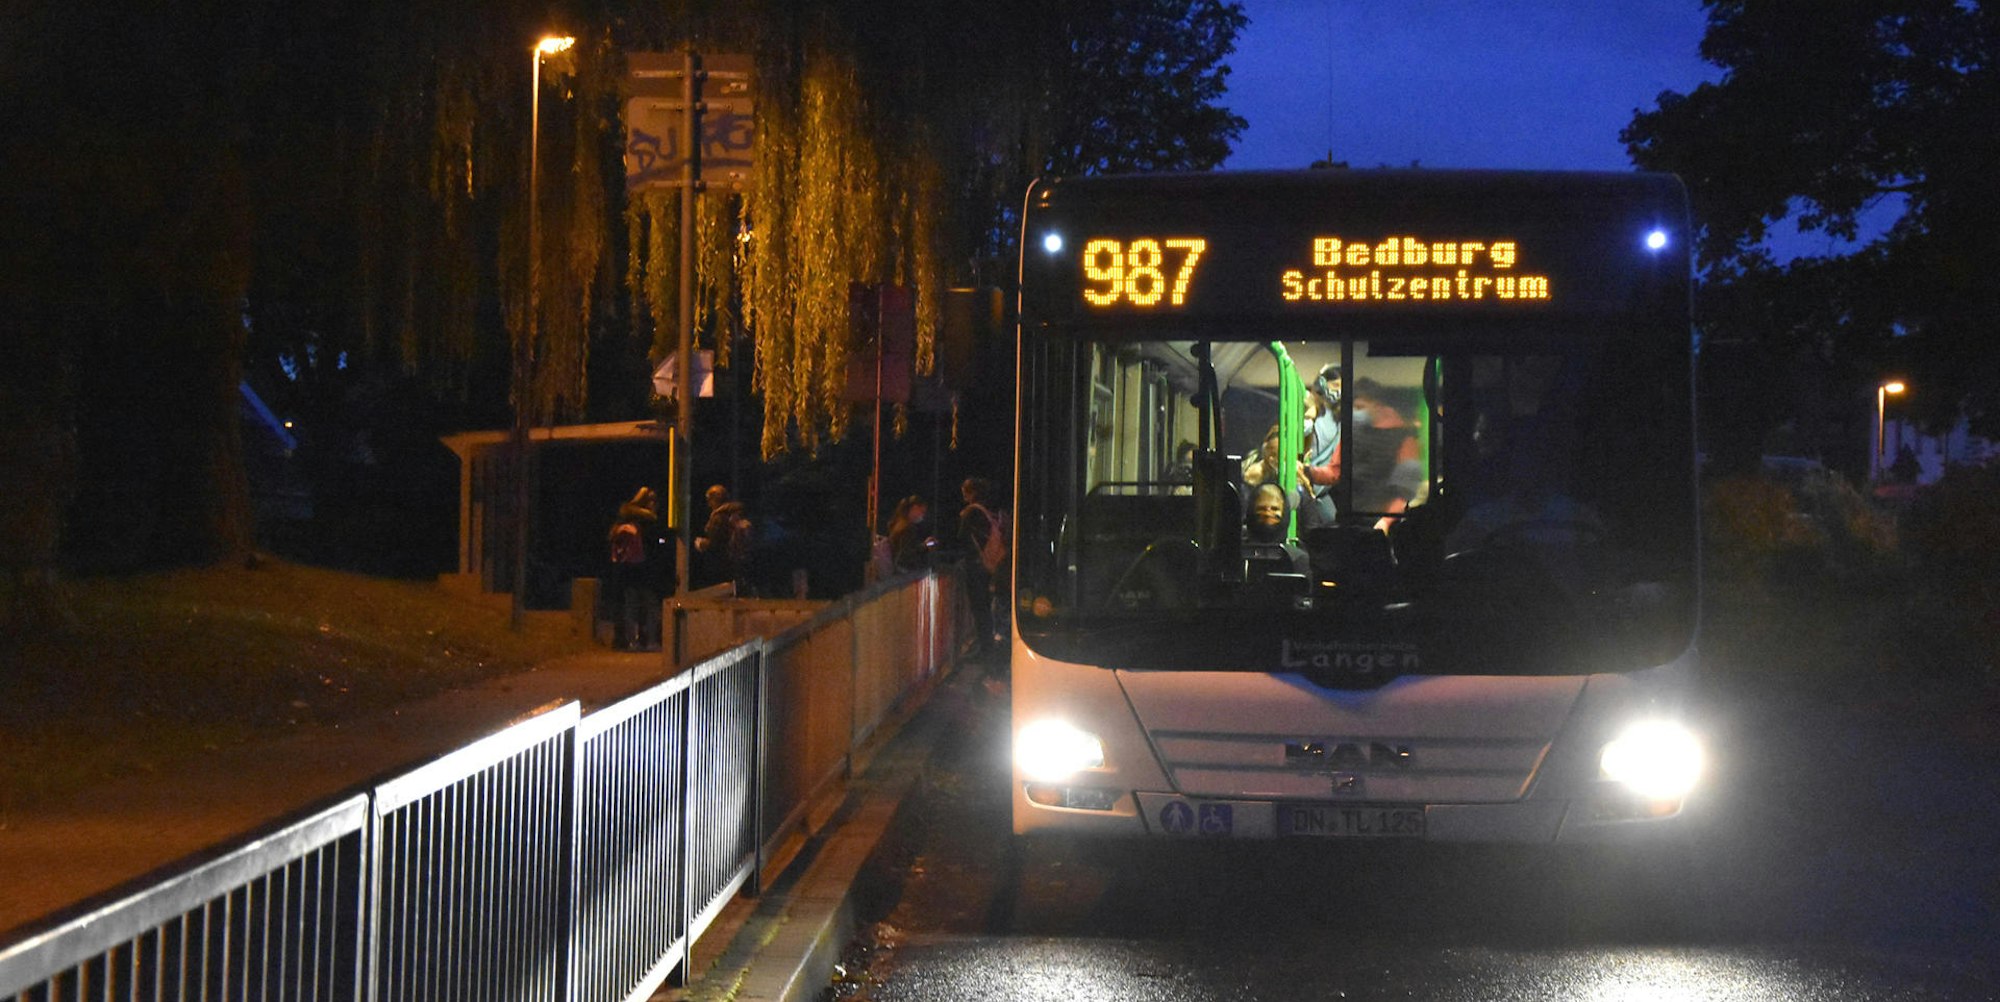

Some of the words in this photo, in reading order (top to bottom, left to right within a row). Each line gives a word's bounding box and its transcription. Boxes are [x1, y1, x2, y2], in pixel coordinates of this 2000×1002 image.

[1313, 237, 1516, 268] Bedburg
[1083, 238, 1206, 306] 987
[1282, 269, 1550, 300] Schulzentrum
[1281, 638, 1420, 672] Langen
[1285, 742, 1410, 766] MAN
[1341, 809, 1370, 833] TL
[1379, 809, 1421, 834] 125
